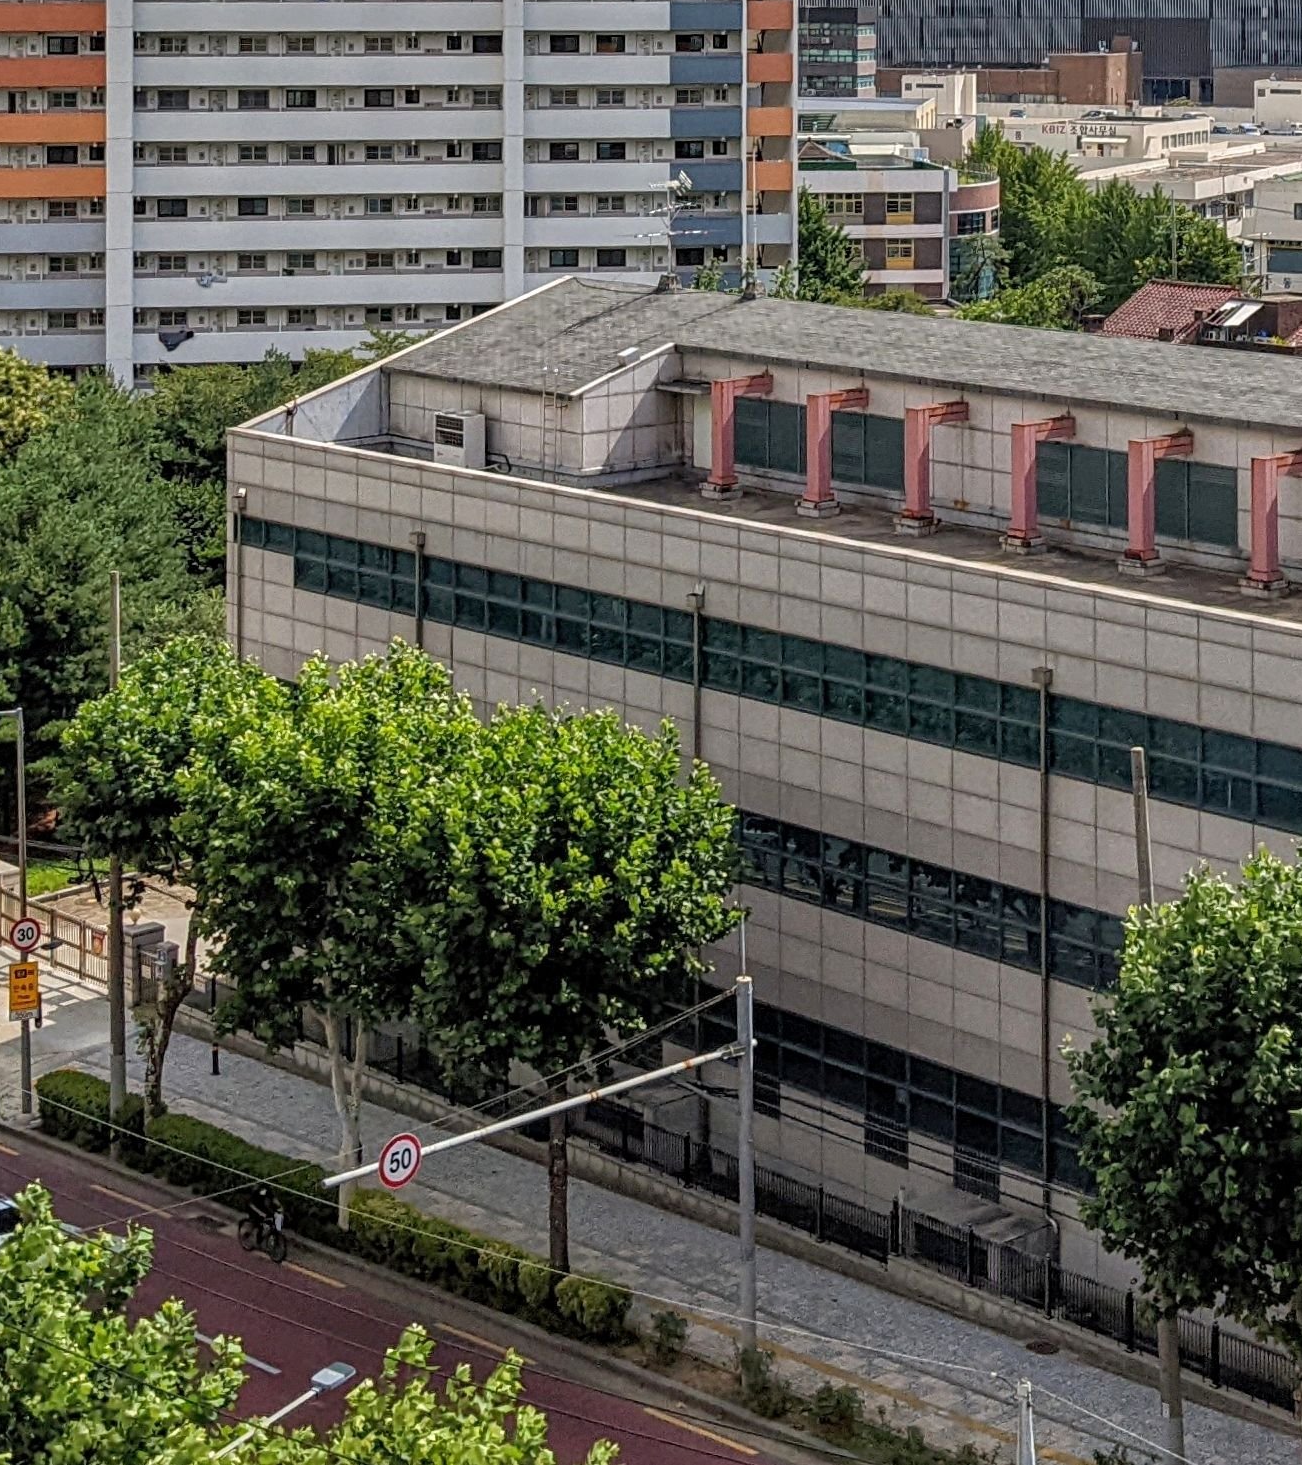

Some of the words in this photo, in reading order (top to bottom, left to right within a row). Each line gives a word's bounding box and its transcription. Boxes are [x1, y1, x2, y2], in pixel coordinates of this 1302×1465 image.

[1041, 124, 1066, 134] KBIZ
[17, 926, 34, 942] 30
[389, 1147, 412, 1174] 50
